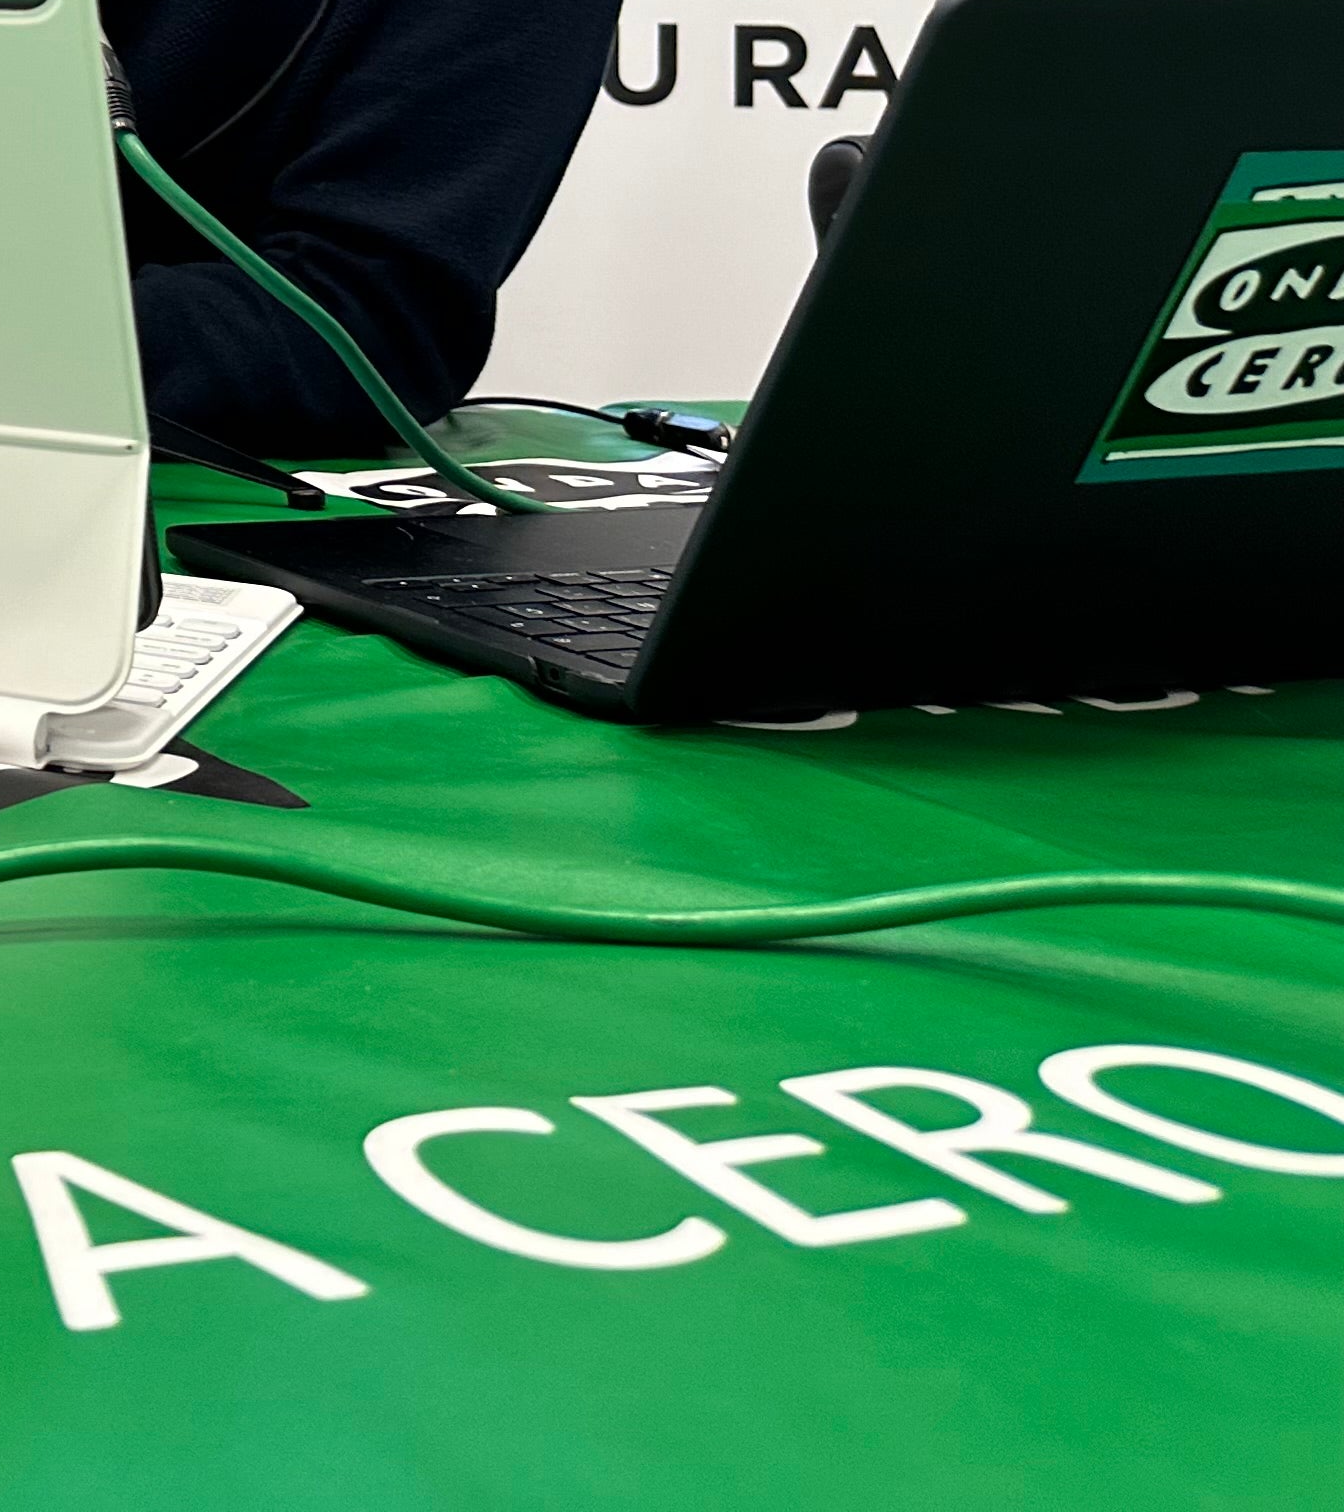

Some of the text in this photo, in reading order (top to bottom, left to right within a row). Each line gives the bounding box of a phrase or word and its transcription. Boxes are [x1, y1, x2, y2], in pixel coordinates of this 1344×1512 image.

[602, 22, 677, 106] U
[1219, 264, 1344, 311] ON
[1187, 344, 1344, 398] CER
[363, 1043, 1344, 1270] CERO
